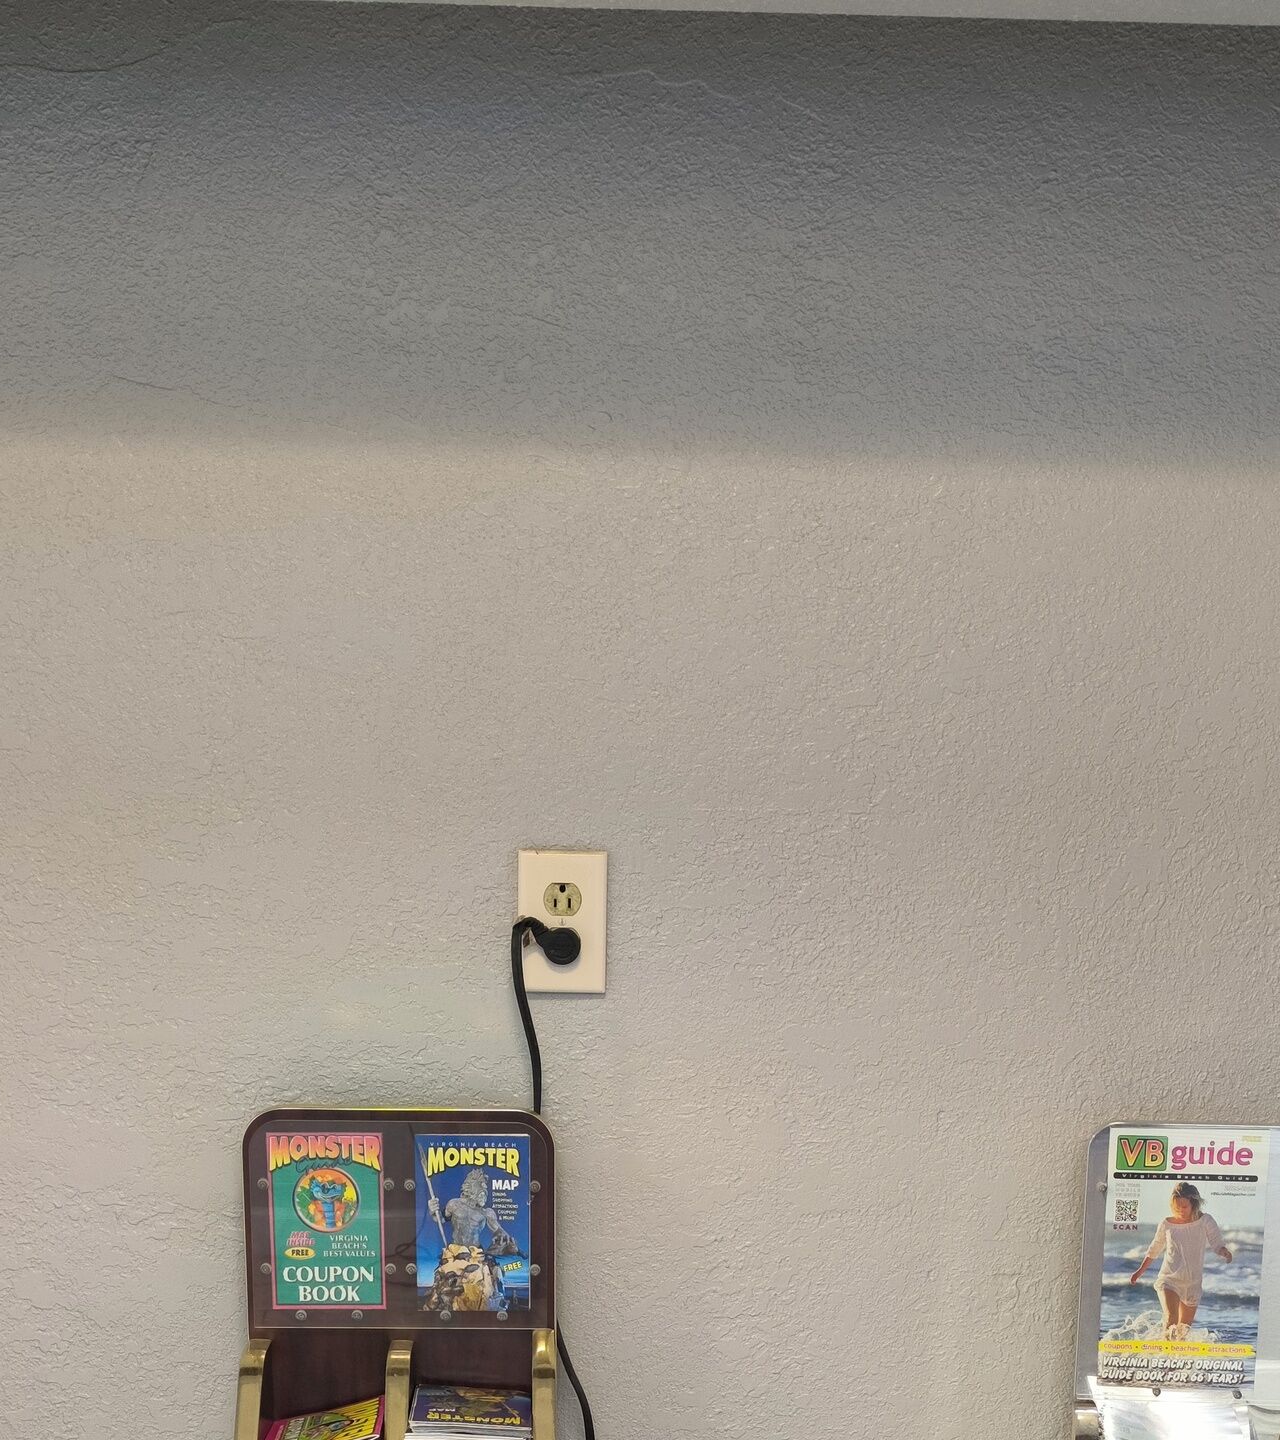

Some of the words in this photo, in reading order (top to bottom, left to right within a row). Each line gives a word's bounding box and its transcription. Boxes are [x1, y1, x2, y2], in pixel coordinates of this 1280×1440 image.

[269, 1134, 381, 1172] MONSTER
[1120, 1139, 1165, 1168] VB
[1171, 1140, 1254, 1171] guide
[427, 1147, 520, 1177] MONSTER
[492, 1179, 520, 1190] MAP
[282, 1265, 374, 1283] COUPON
[503, 1261, 522, 1272] FREE
[298, 1285, 360, 1302] BOOK
[1104, 1343, 1133, 1351] coupons
[1171, 1344, 1200, 1352] beaches
[1103, 1356, 1148, 1369] VIRGINIA
[1151, 1357, 1194, 1370] BEACH'S
[1195, 1359, 1243, 1371] ORIGINAL
[1102, 1369, 1134, 1380] GUIDE
[1135, 1370, 1166, 1381] BOOK
[1166, 1371, 1187, 1382] FOR
[1191, 1373, 1203, 1382] 66
[1207, 1373, 1244, 1384] YEARS!
[427, 1411, 521, 1425] MONSTER
